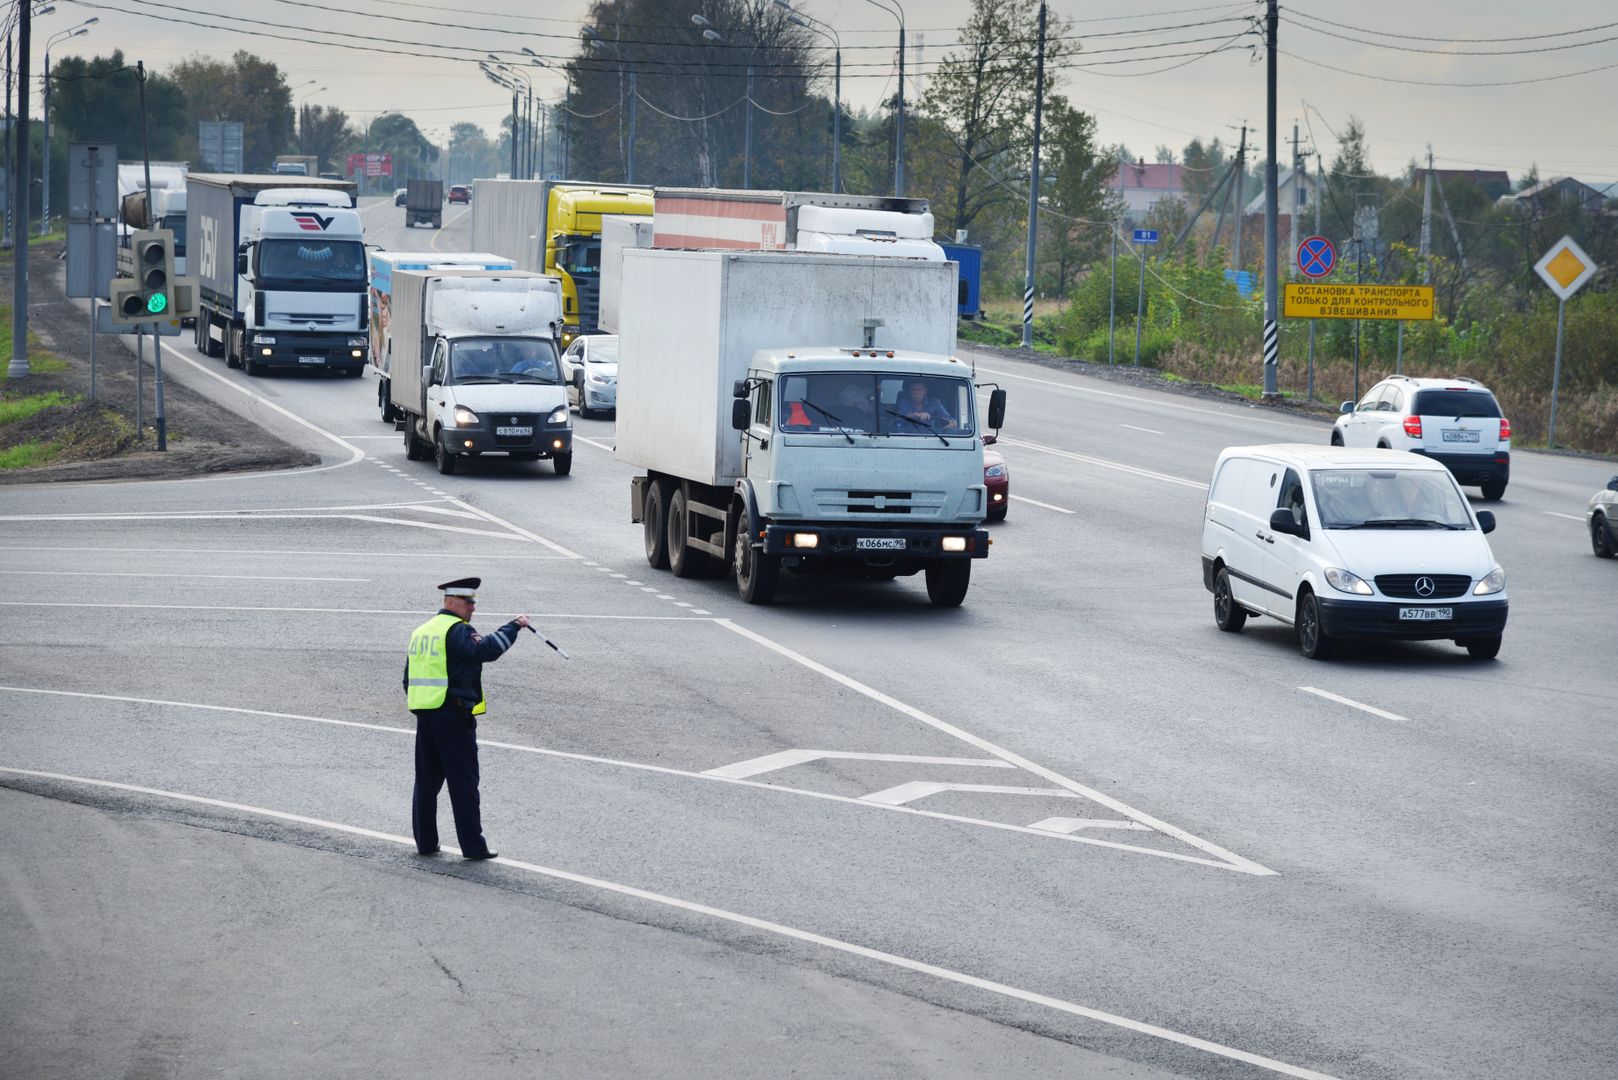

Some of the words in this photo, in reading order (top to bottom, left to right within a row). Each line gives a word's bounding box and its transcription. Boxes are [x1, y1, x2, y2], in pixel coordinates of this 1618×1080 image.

[1141, 231, 1151, 239] 81
[1297, 286, 1355, 296] ОСТАНОВКА
[1359, 287, 1420, 297] ТРАНСПОРТА
[1290, 296, 1328, 305] ТОЛЬКО
[1331, 297, 1351, 305] ДЛЯ
[1354, 298, 1429, 307] КОНТРОЛЬНОГО
[1320, 307, 1398, 316] ВЗВЕШИВАНИЯ
